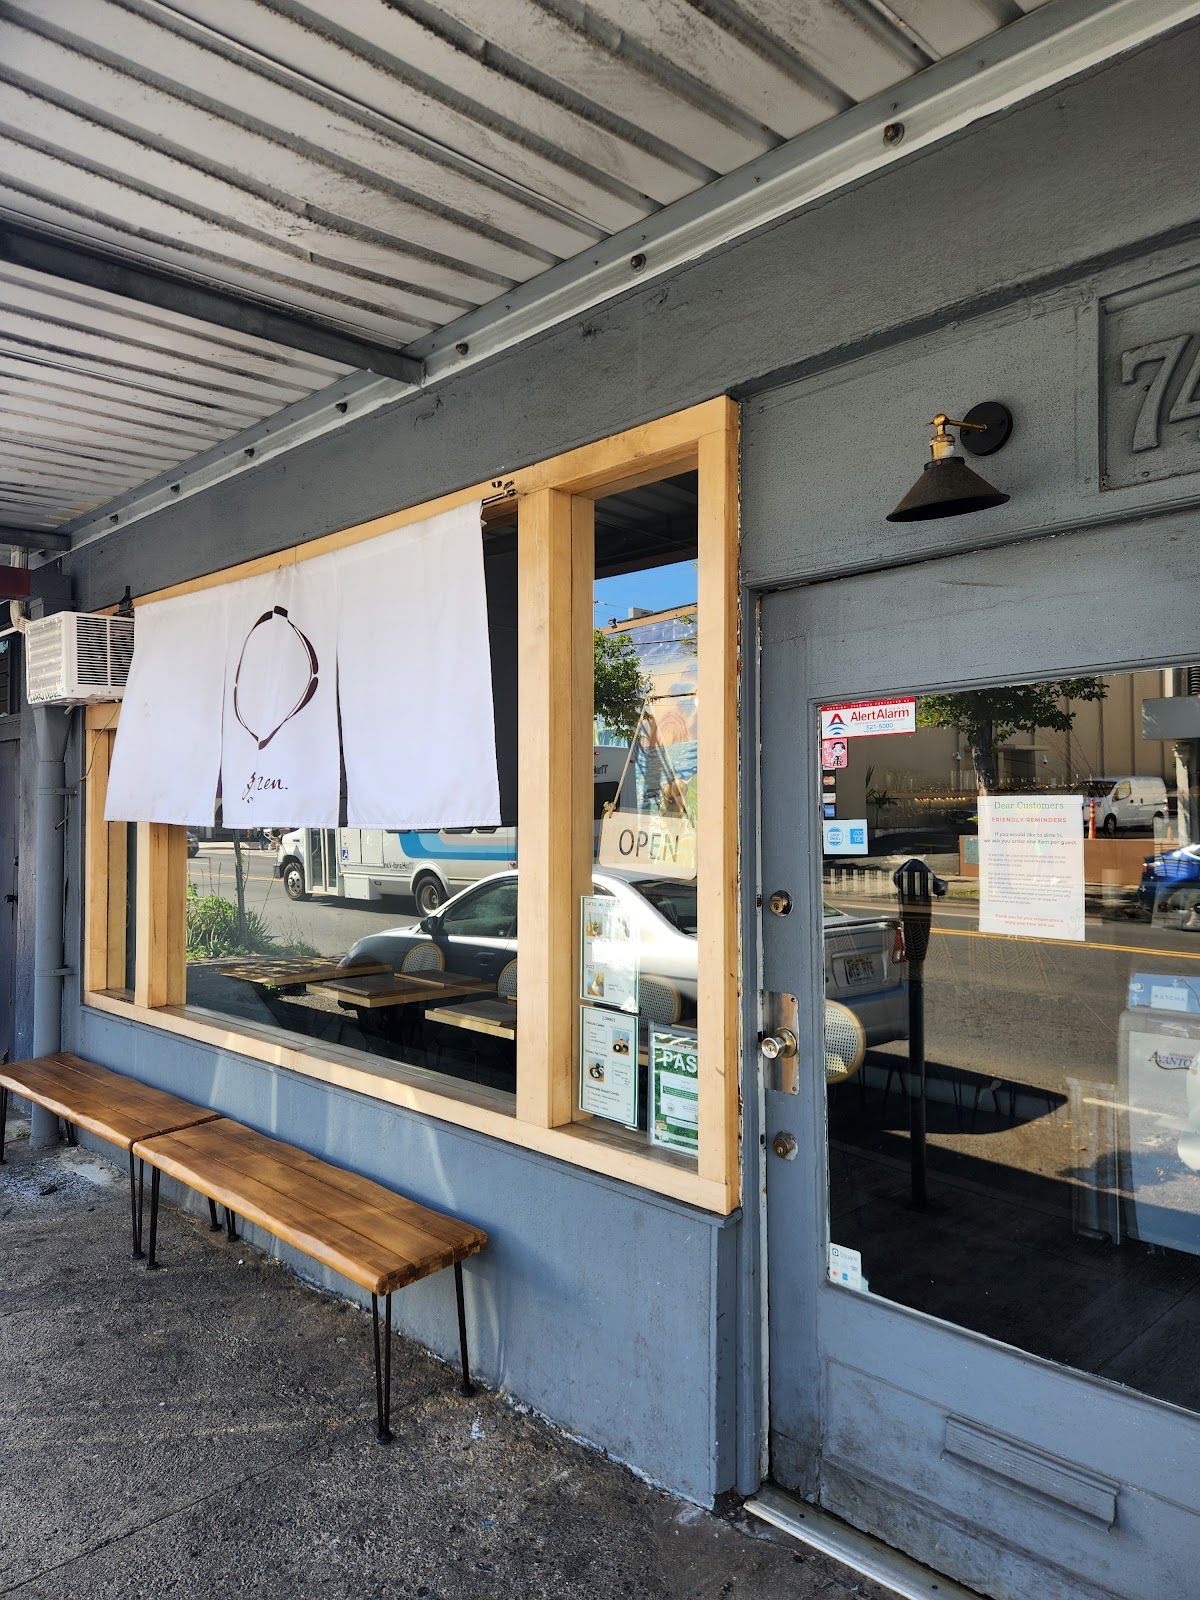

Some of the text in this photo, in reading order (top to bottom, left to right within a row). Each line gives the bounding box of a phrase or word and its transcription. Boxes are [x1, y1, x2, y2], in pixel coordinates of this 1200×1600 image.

[1017, 802, 1064, 810] Customers
[618, 828, 678, 862] OPEN
[663, 1050, 698, 1074] PAS
